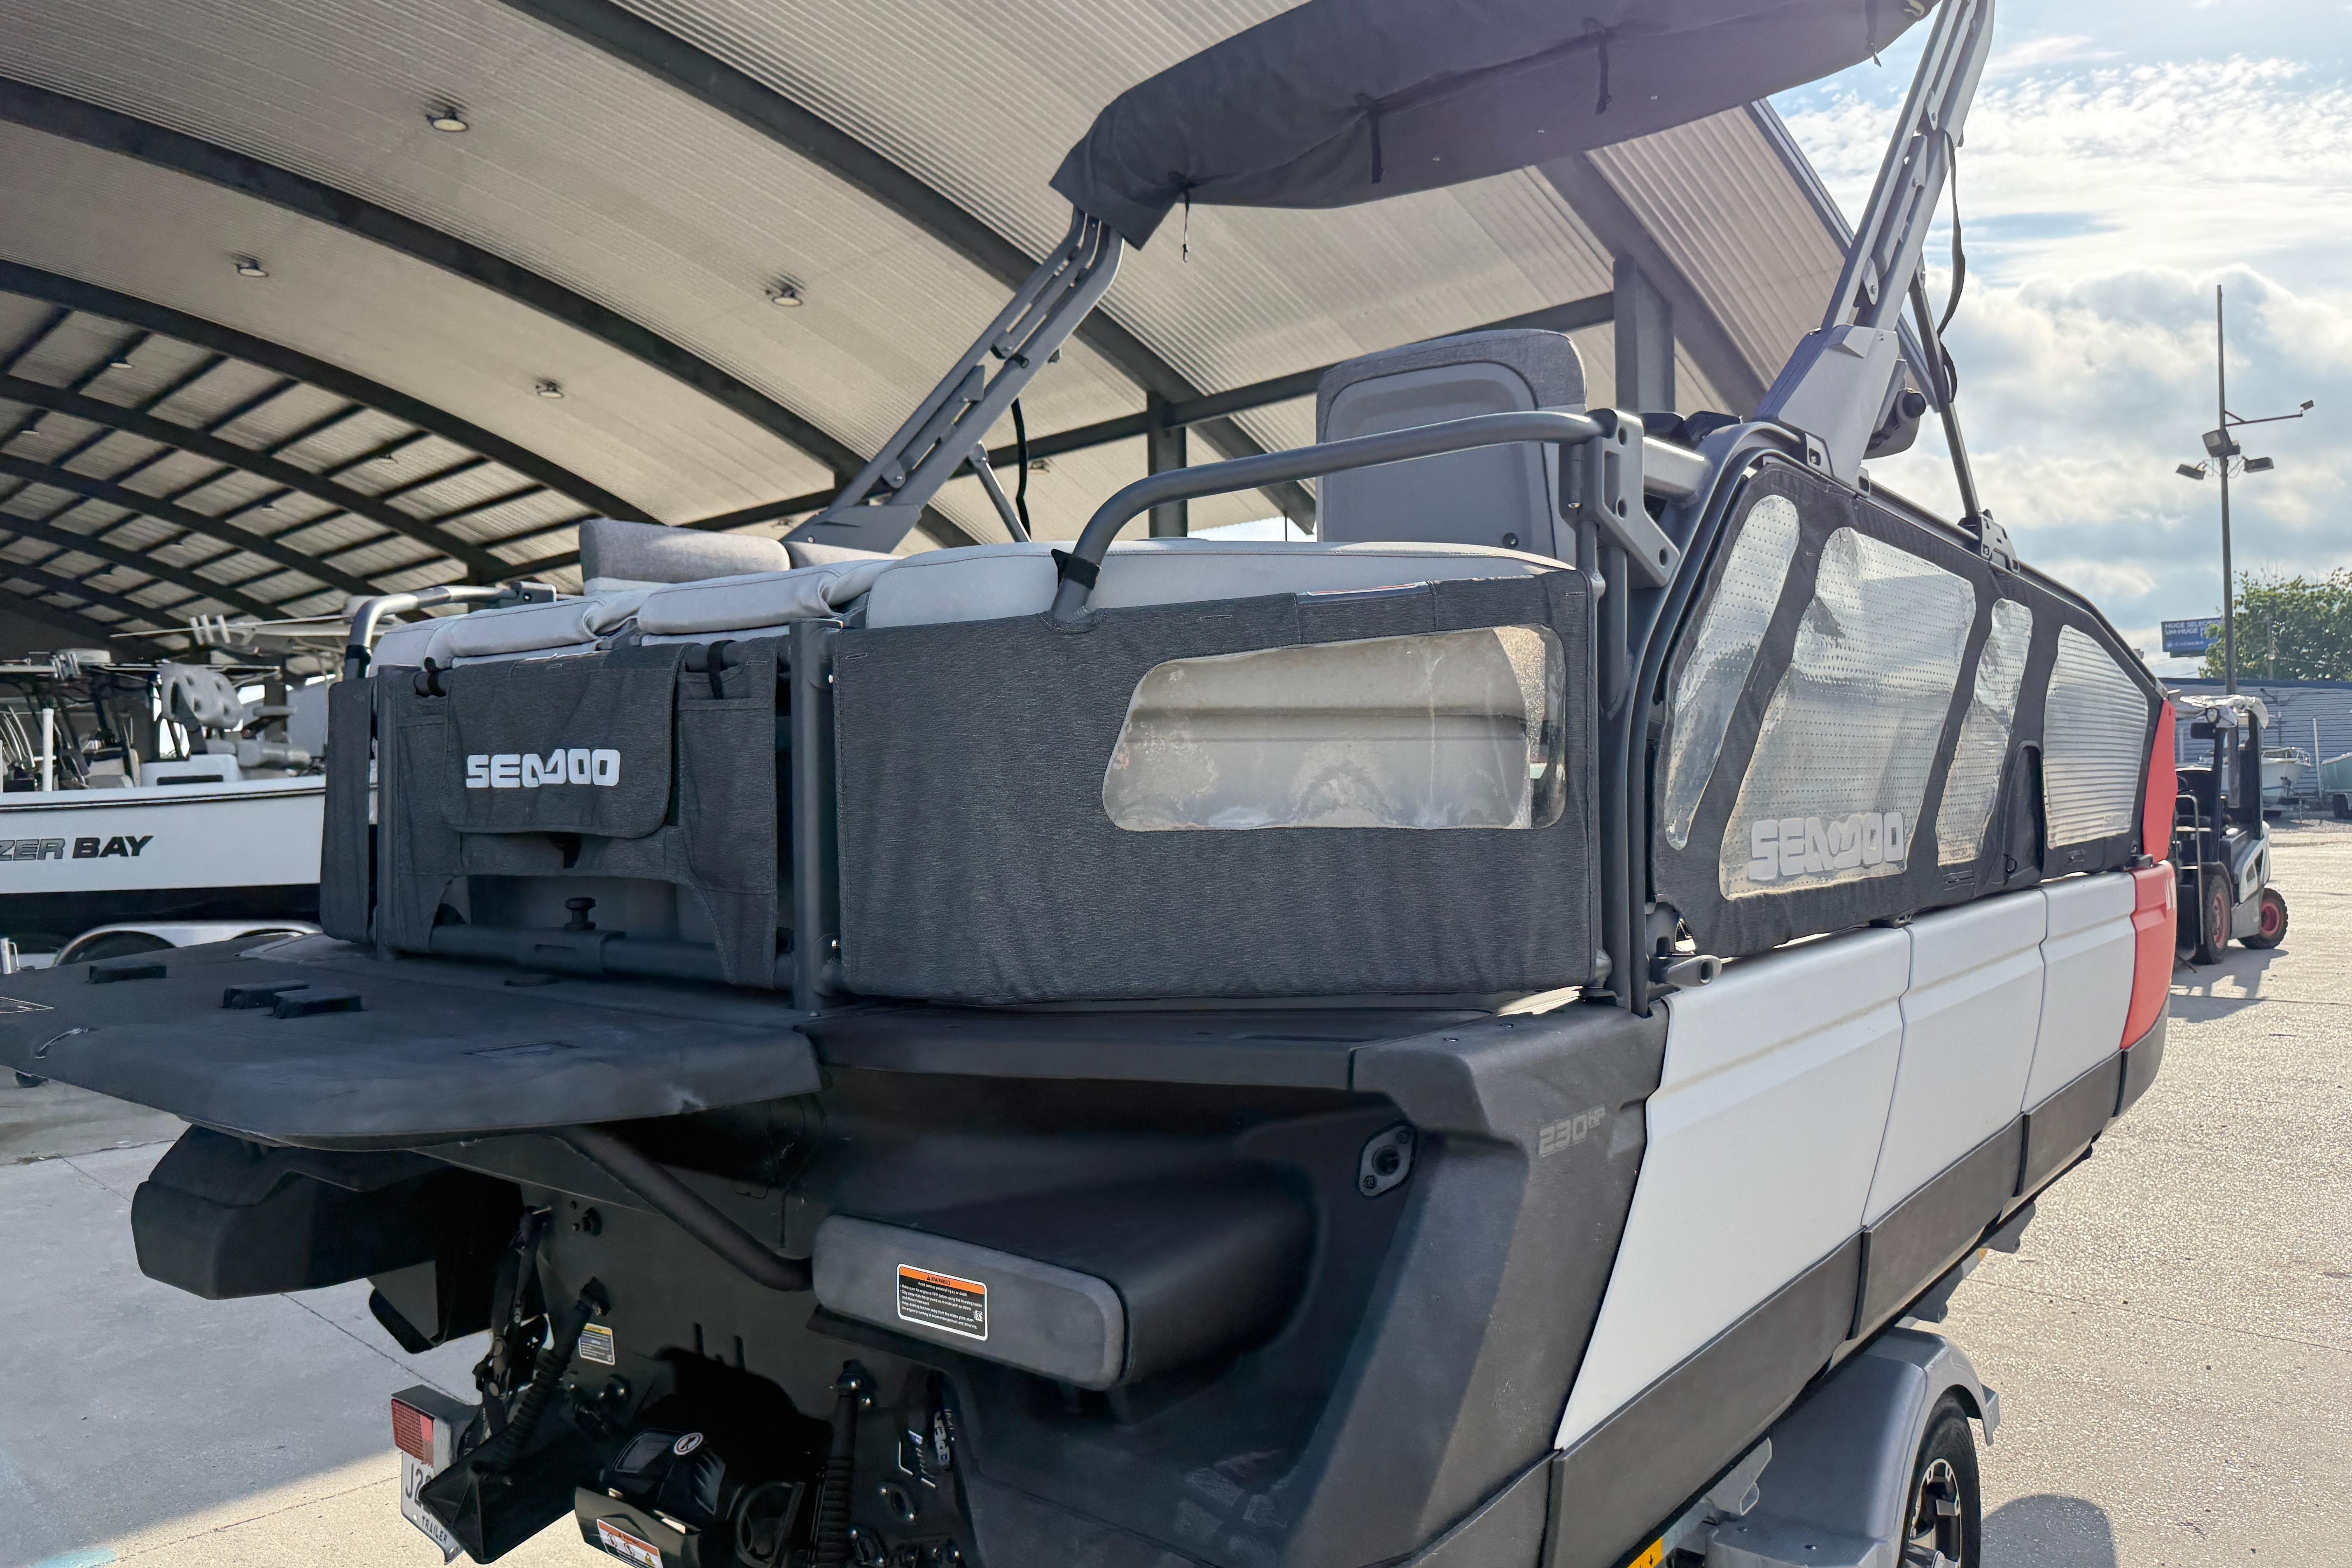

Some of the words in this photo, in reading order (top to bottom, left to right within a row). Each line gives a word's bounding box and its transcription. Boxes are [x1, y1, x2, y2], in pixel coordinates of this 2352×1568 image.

[72, 835, 153, 859] BAY
[930, 1276, 950, 1285] WARNING
[405, 1463, 432, 1507] J2
[421, 1515, 448, 1545] TRAILER
